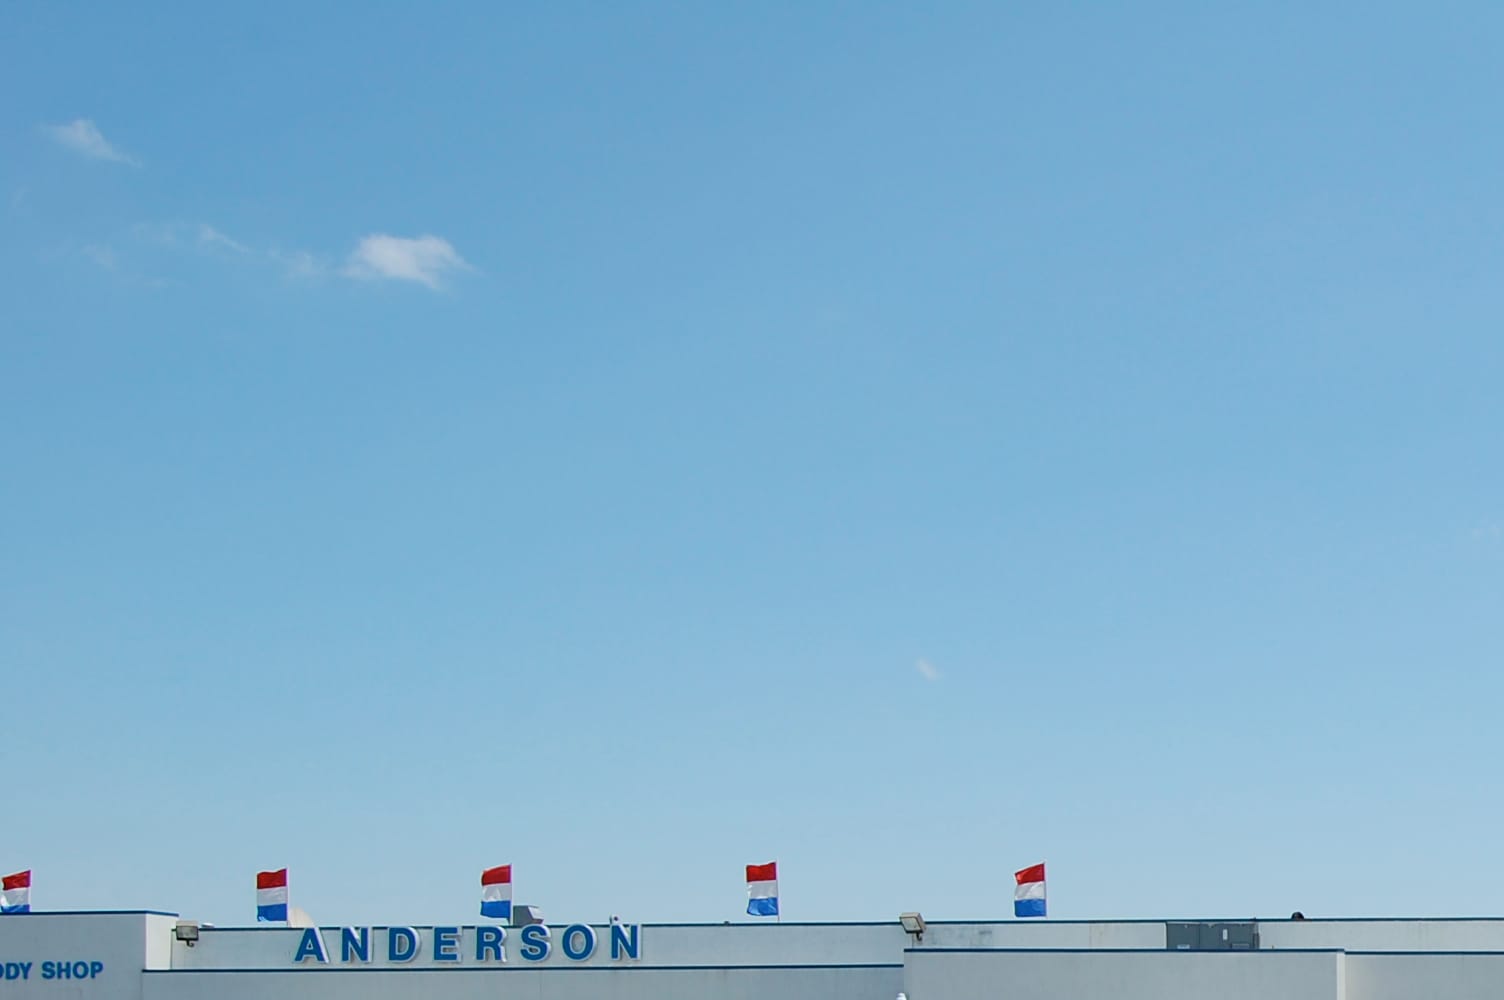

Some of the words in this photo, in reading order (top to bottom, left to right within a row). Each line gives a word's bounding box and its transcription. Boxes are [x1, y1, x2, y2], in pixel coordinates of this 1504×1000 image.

[294, 924, 642, 964] ANDERSON
[0, 962, 33, 980] DY
[41, 961, 104, 980] SHOP
